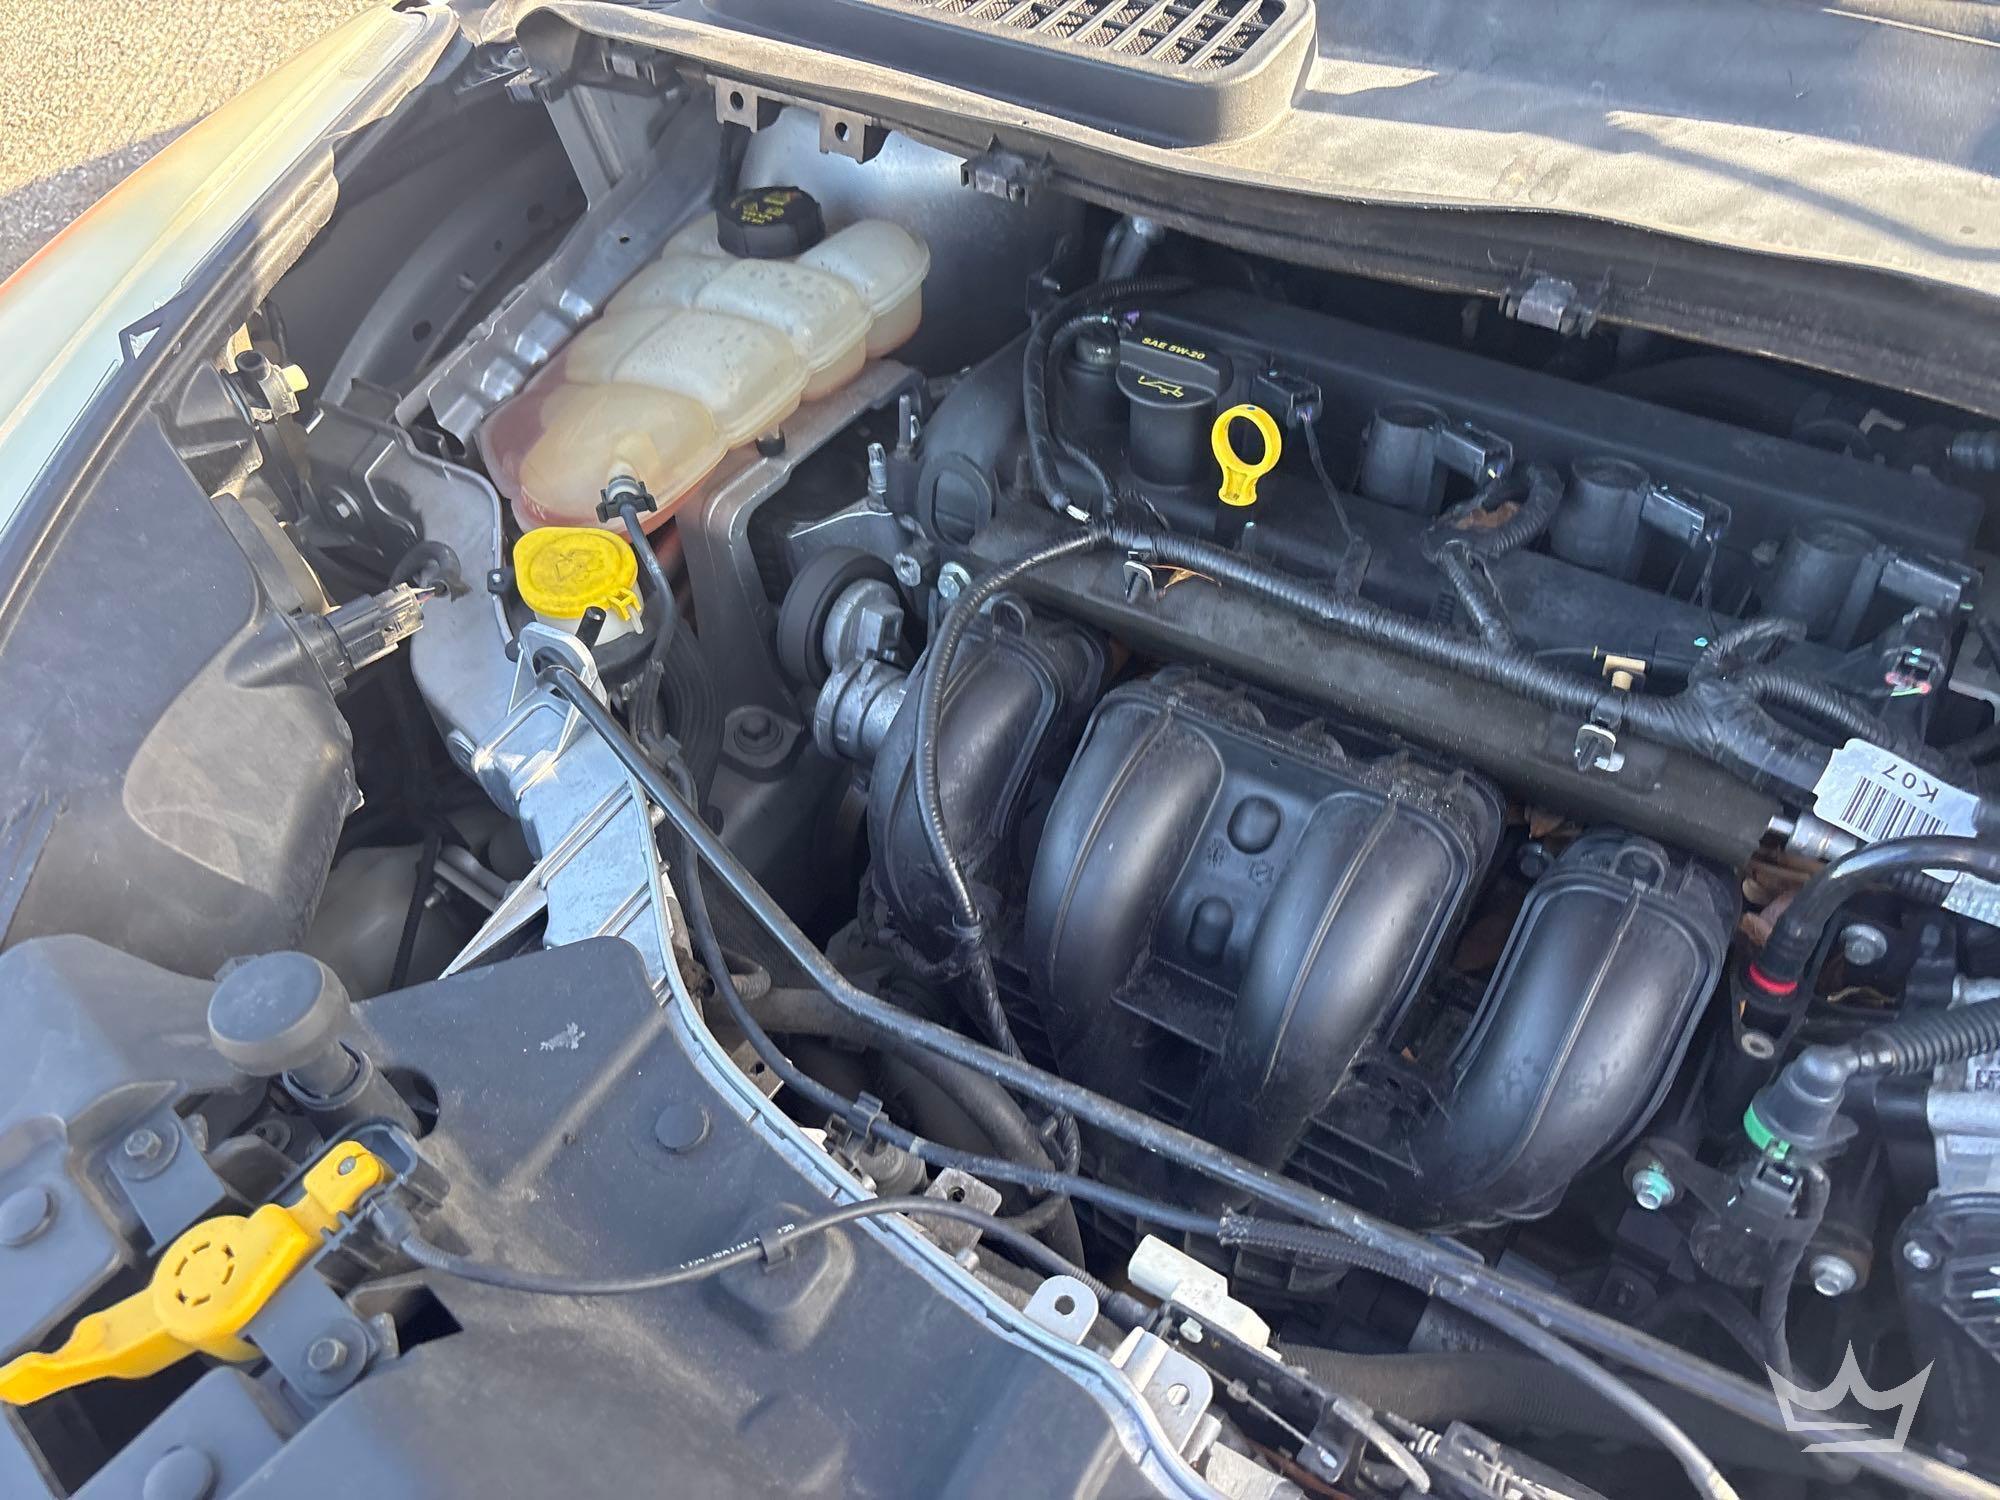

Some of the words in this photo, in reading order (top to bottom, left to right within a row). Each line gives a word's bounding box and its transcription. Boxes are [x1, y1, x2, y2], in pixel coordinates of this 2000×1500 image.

[1141, 337, 1167, 349] SAE
[1168, 344, 1206, 361] 5W-20
[1882, 763, 1939, 804] K07
